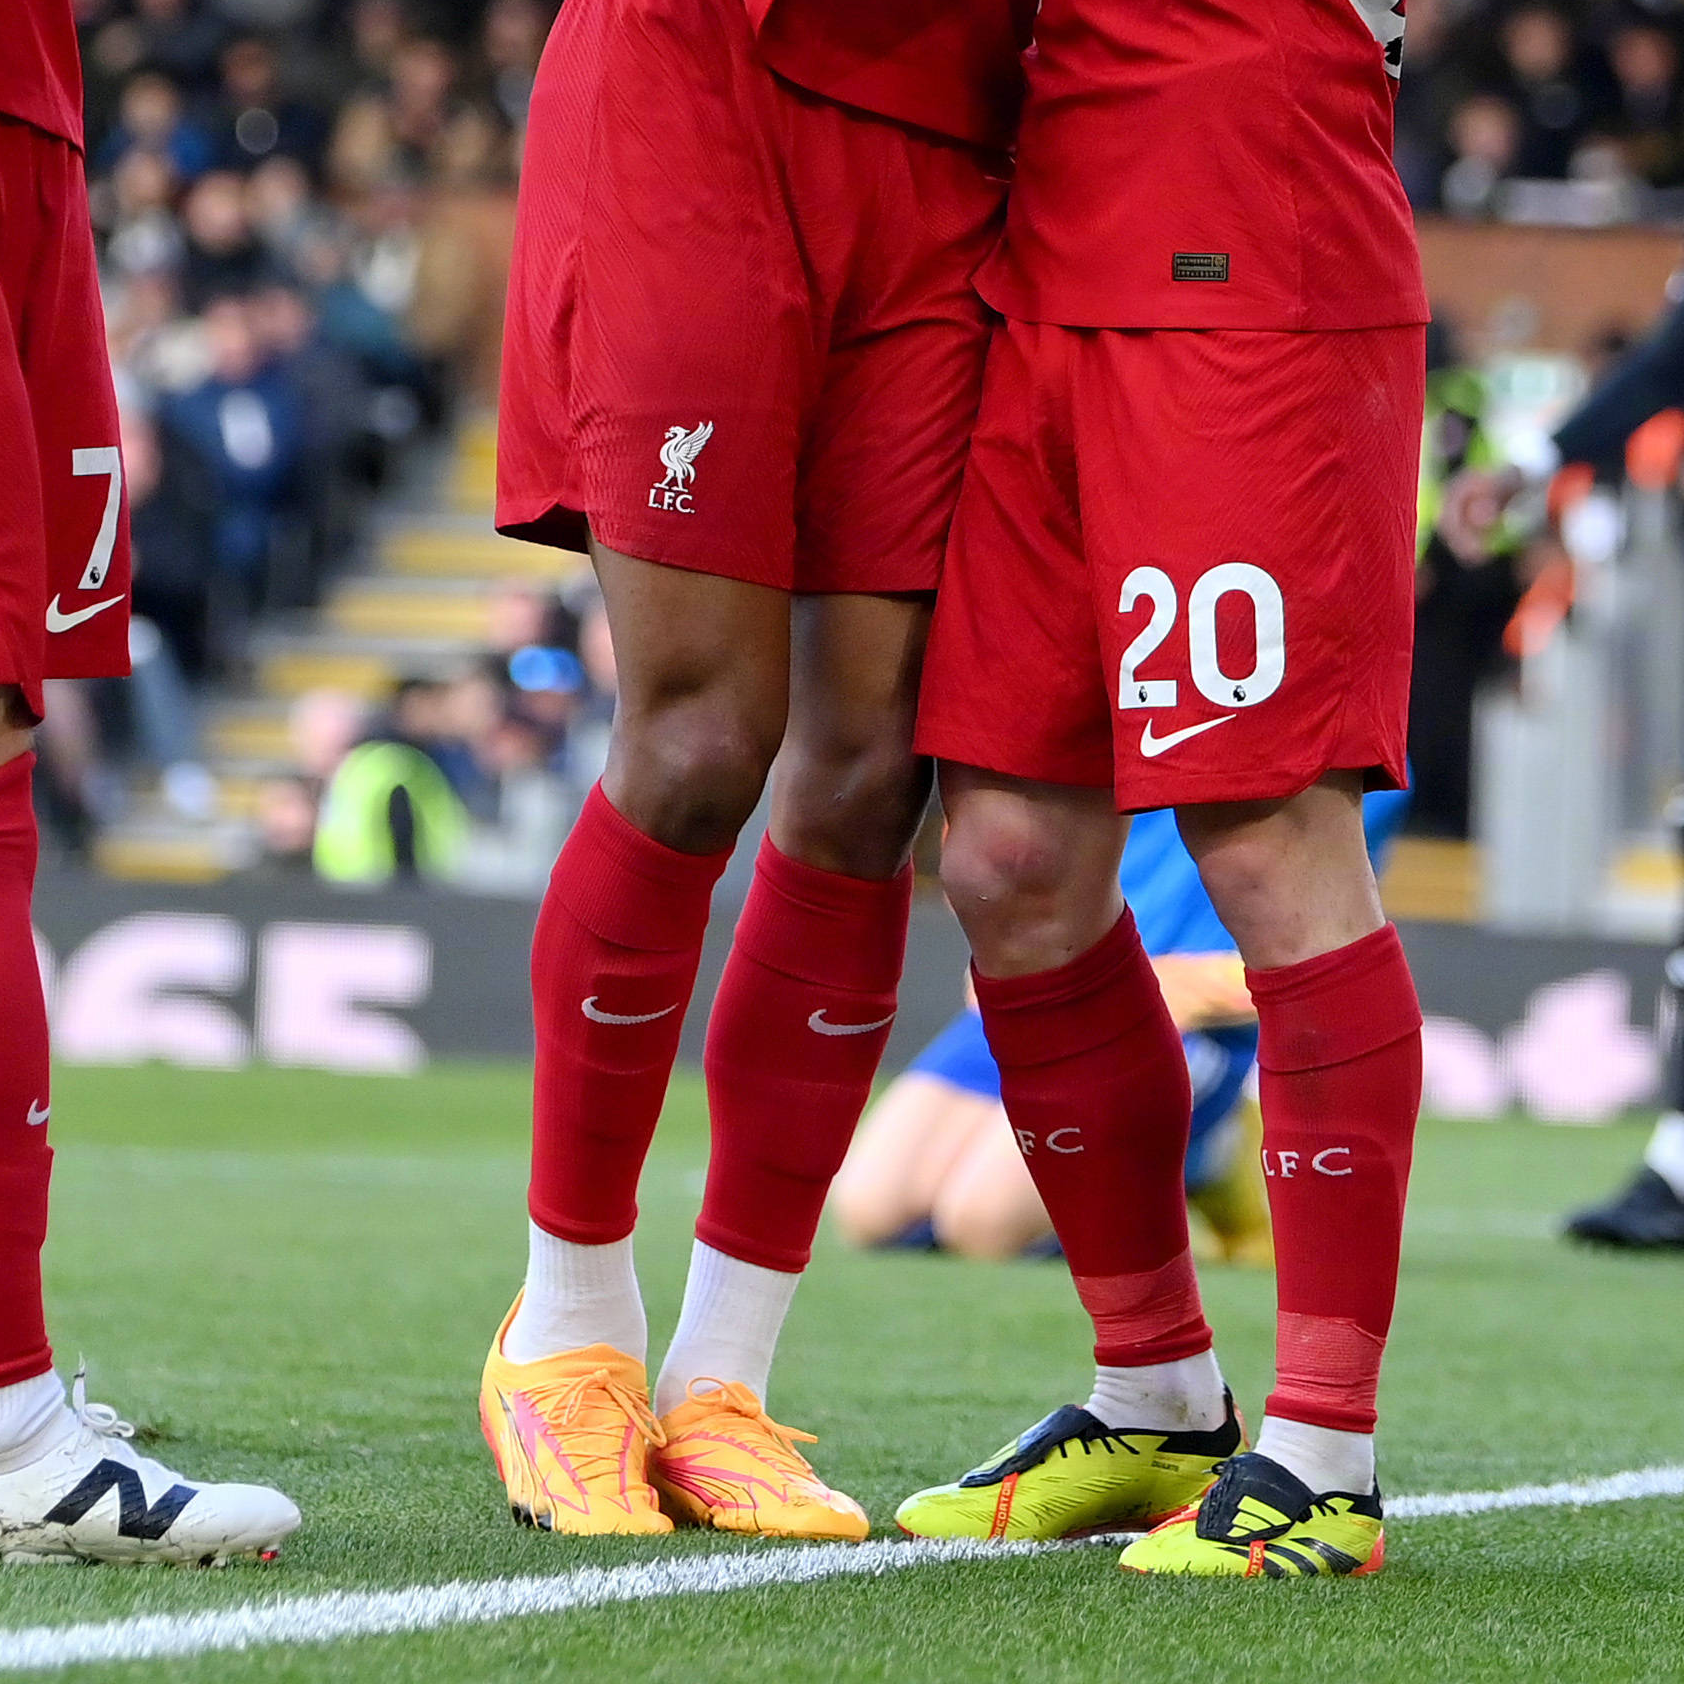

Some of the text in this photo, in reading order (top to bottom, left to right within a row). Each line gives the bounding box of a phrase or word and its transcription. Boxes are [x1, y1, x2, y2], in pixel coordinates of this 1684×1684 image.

[72, 446, 122, 590] 7
[1117, 562, 1286, 710] 20
[1015, 1127, 1085, 1156] FC
[995, 1481, 1013, 1536] REDATOR
